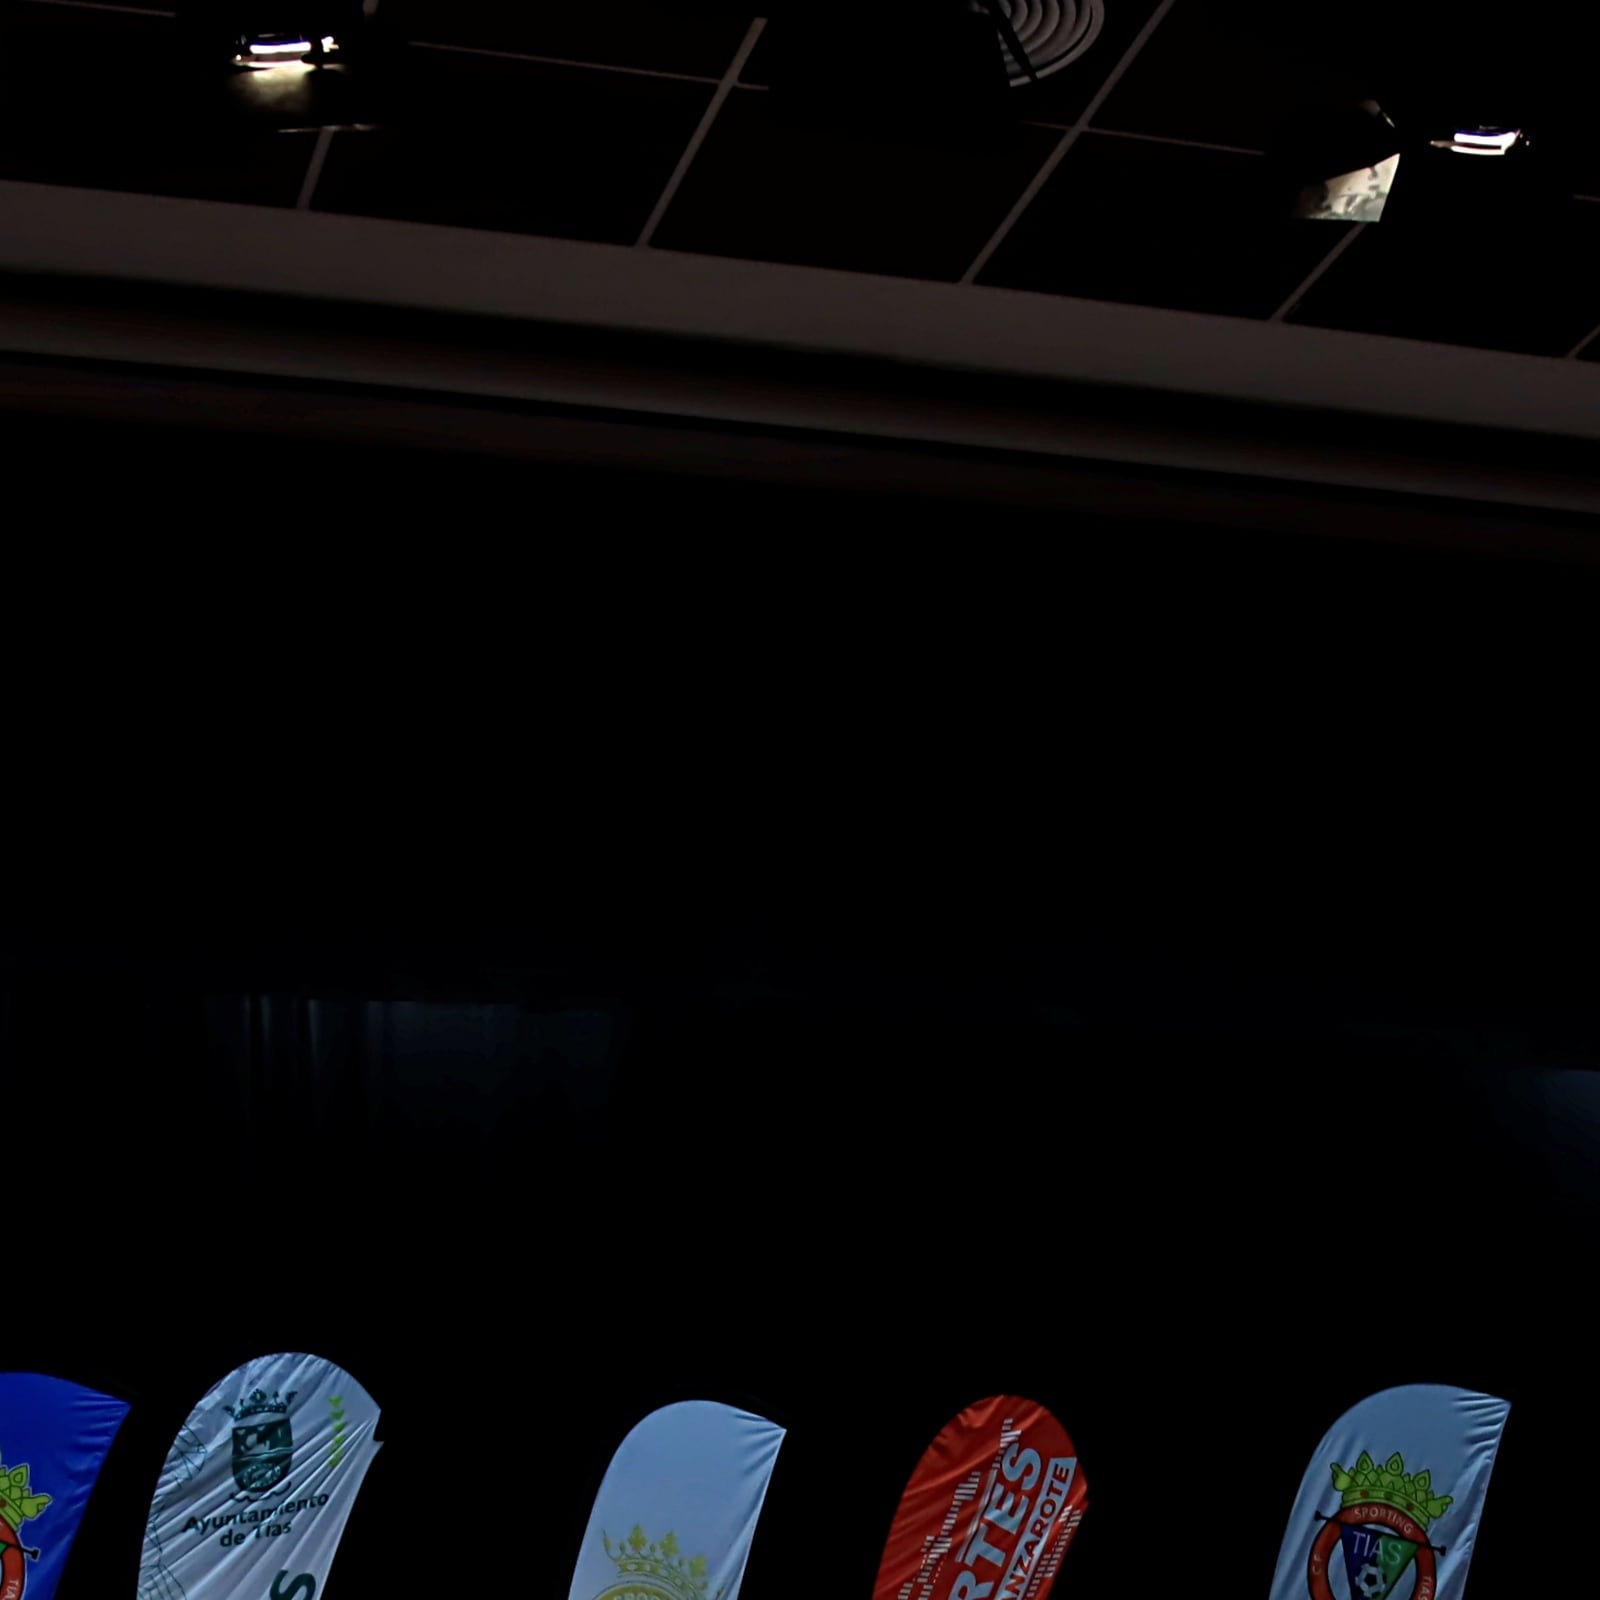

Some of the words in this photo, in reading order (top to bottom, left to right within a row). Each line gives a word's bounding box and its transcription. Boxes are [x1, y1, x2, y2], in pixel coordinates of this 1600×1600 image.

[1354, 1507, 1413, 1535] SPORTING
[220, 1528, 246, 1547] de
[1353, 1531, 1403, 1565] TIAS
